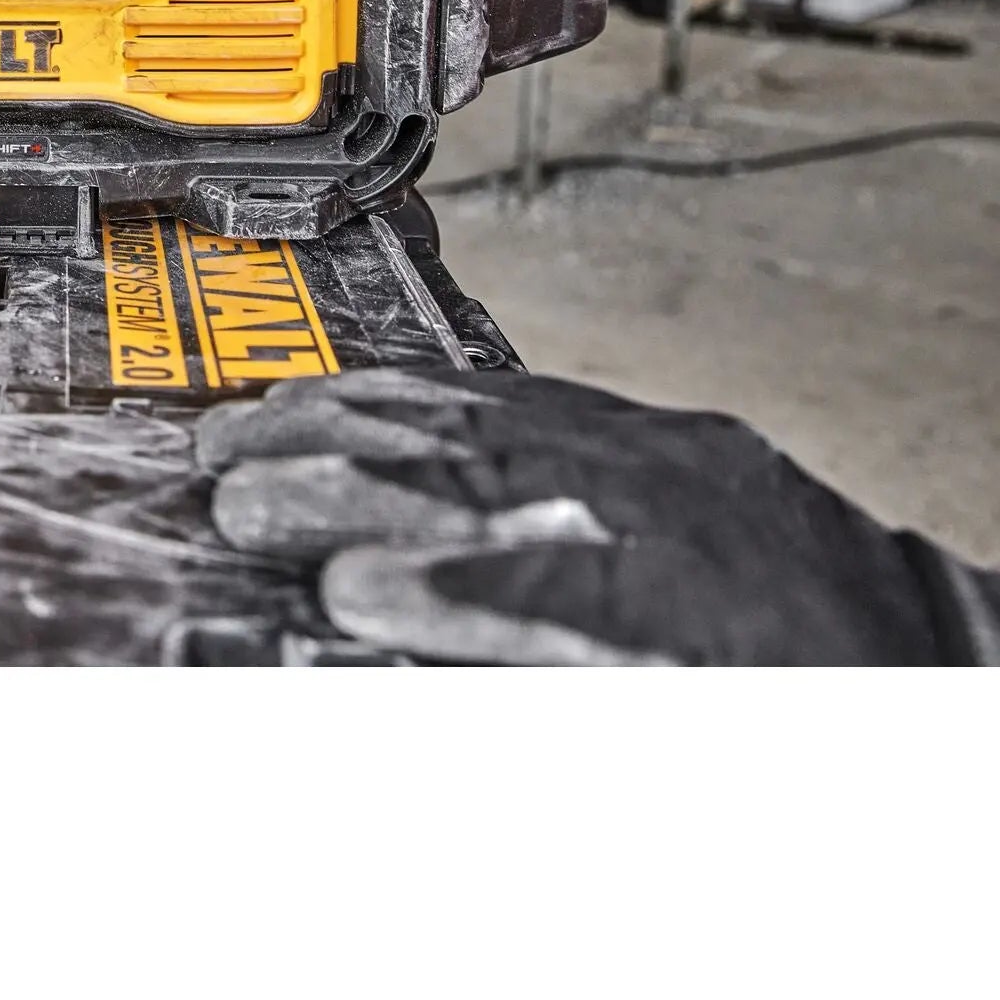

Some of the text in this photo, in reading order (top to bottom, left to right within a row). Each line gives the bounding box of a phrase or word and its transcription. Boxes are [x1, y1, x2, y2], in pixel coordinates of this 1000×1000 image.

[108, 219, 174, 380] OUGHSYSTEM 2.0
[191, 234, 326, 379] EWALT
